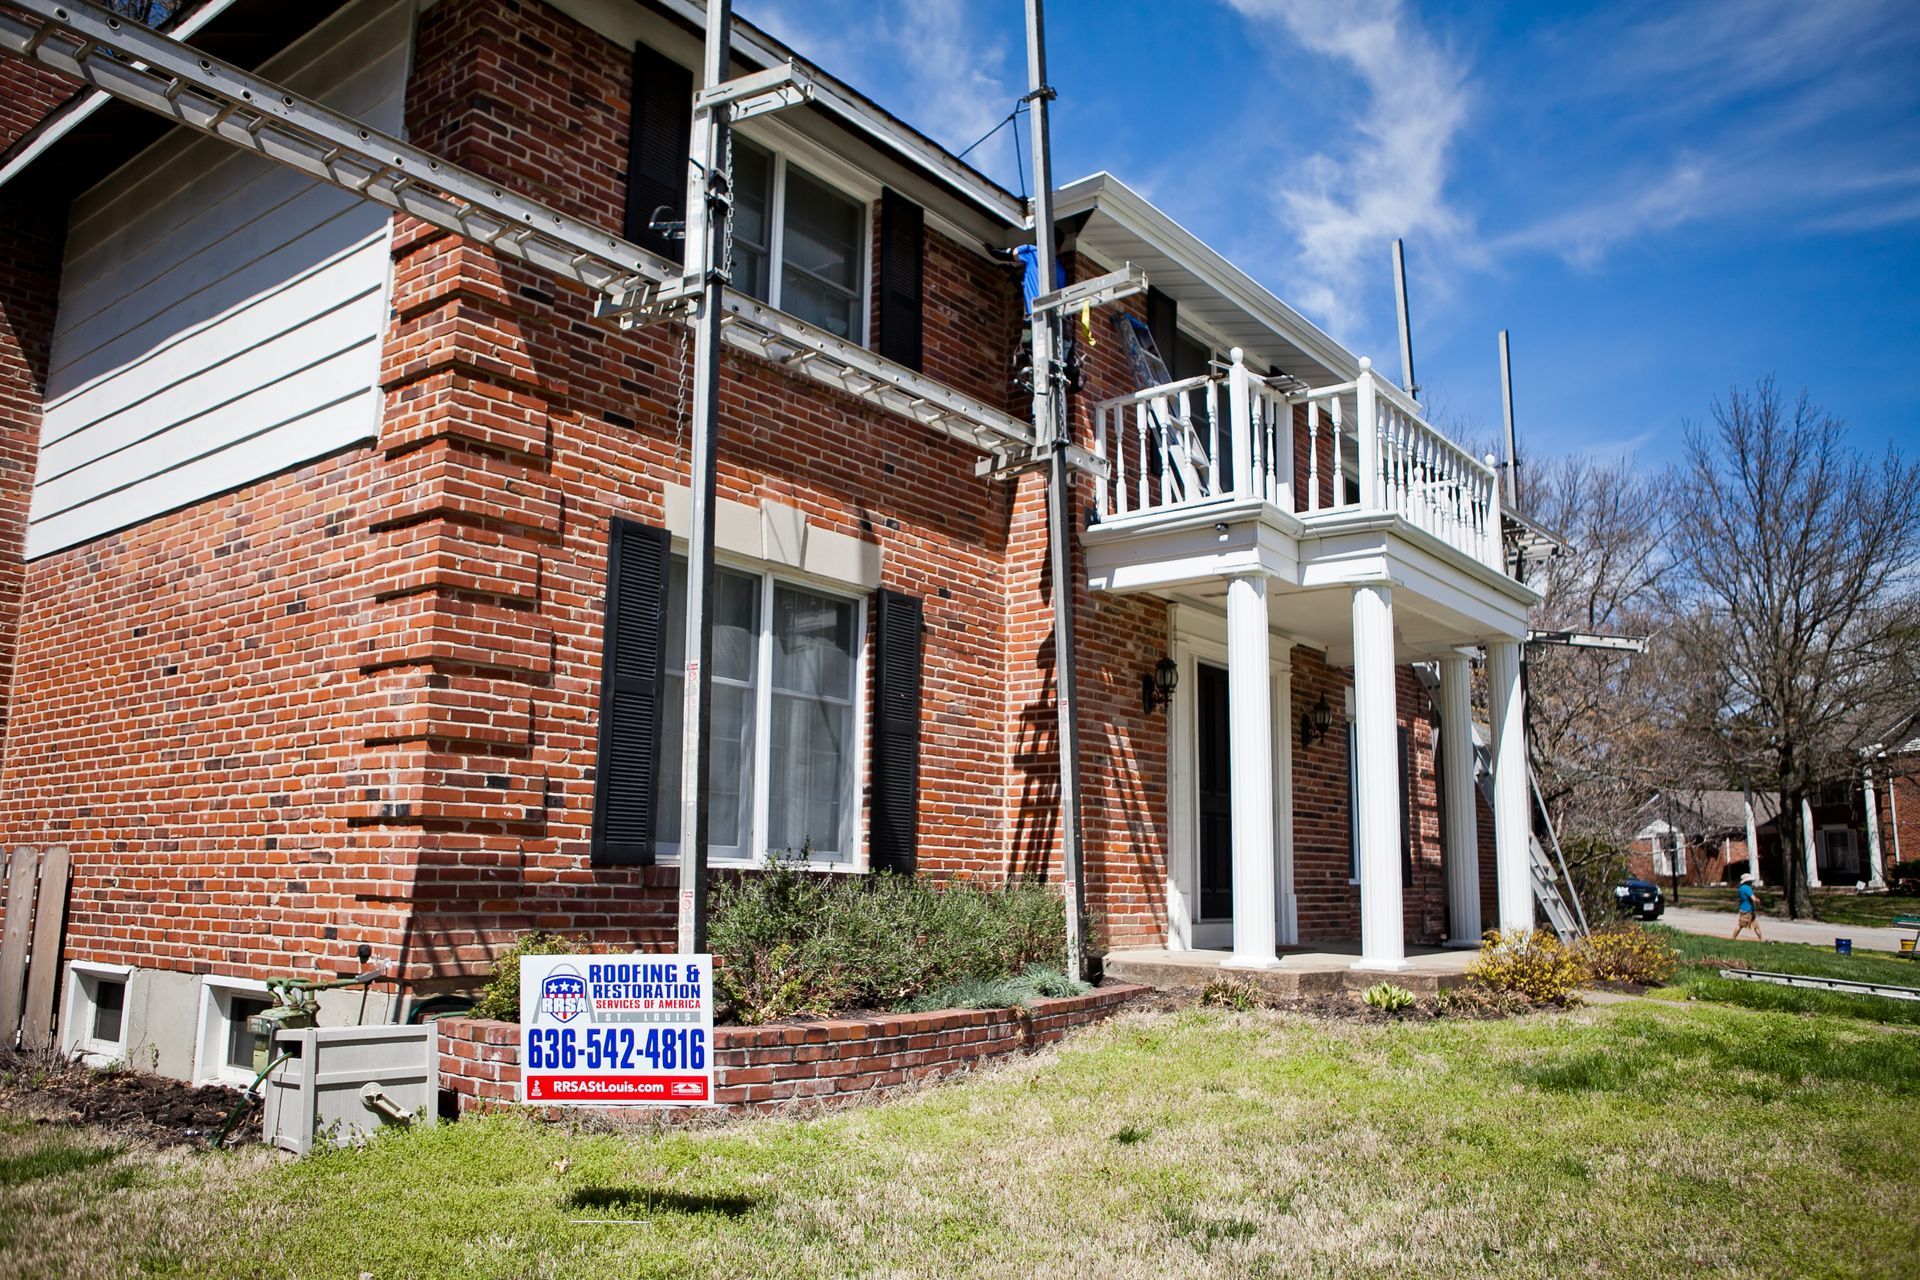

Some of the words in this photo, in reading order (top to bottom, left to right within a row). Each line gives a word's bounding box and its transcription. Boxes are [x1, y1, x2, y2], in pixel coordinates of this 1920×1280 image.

[589, 964, 678, 983] ROOFING
[686, 964, 700, 983] &
[593, 984, 701, 999] RESTORATION
[541, 997, 588, 1013] RRSA
[596, 1000, 640, 1009] SERVICES
[644, 1000, 655, 1009] OF
[659, 1000, 701, 1009] AMERICA
[605, 1012, 631, 1021] ST.
[644, 1012, 691, 1021] LOUIS
[528, 1028, 705, 1070] 636-542-4816
[553, 1081, 664, 1093] RRSAStLouis.com
